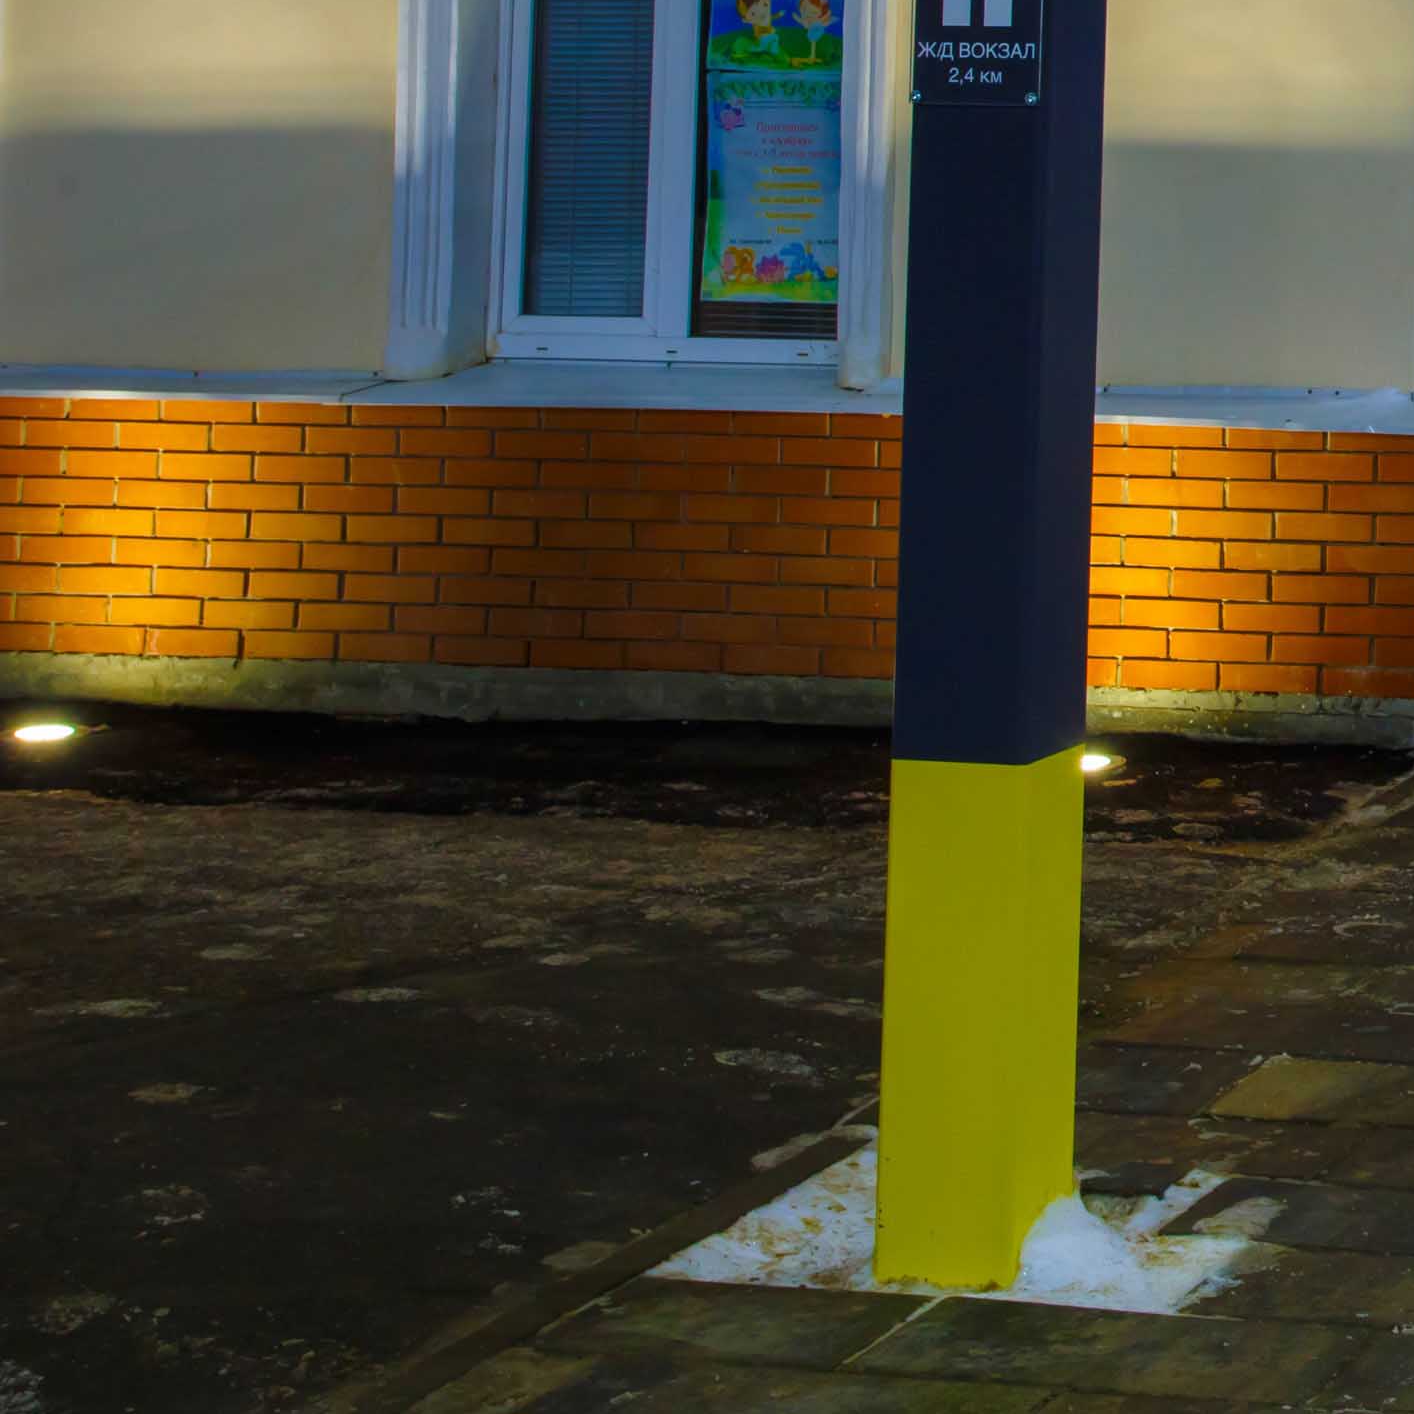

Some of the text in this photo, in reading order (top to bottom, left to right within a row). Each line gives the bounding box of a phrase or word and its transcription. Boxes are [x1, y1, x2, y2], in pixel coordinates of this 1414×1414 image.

[917, 42, 1036, 62] Ж/Д ВОКЗАЛ
[948, 67, 1003, 85] 2,4 км
